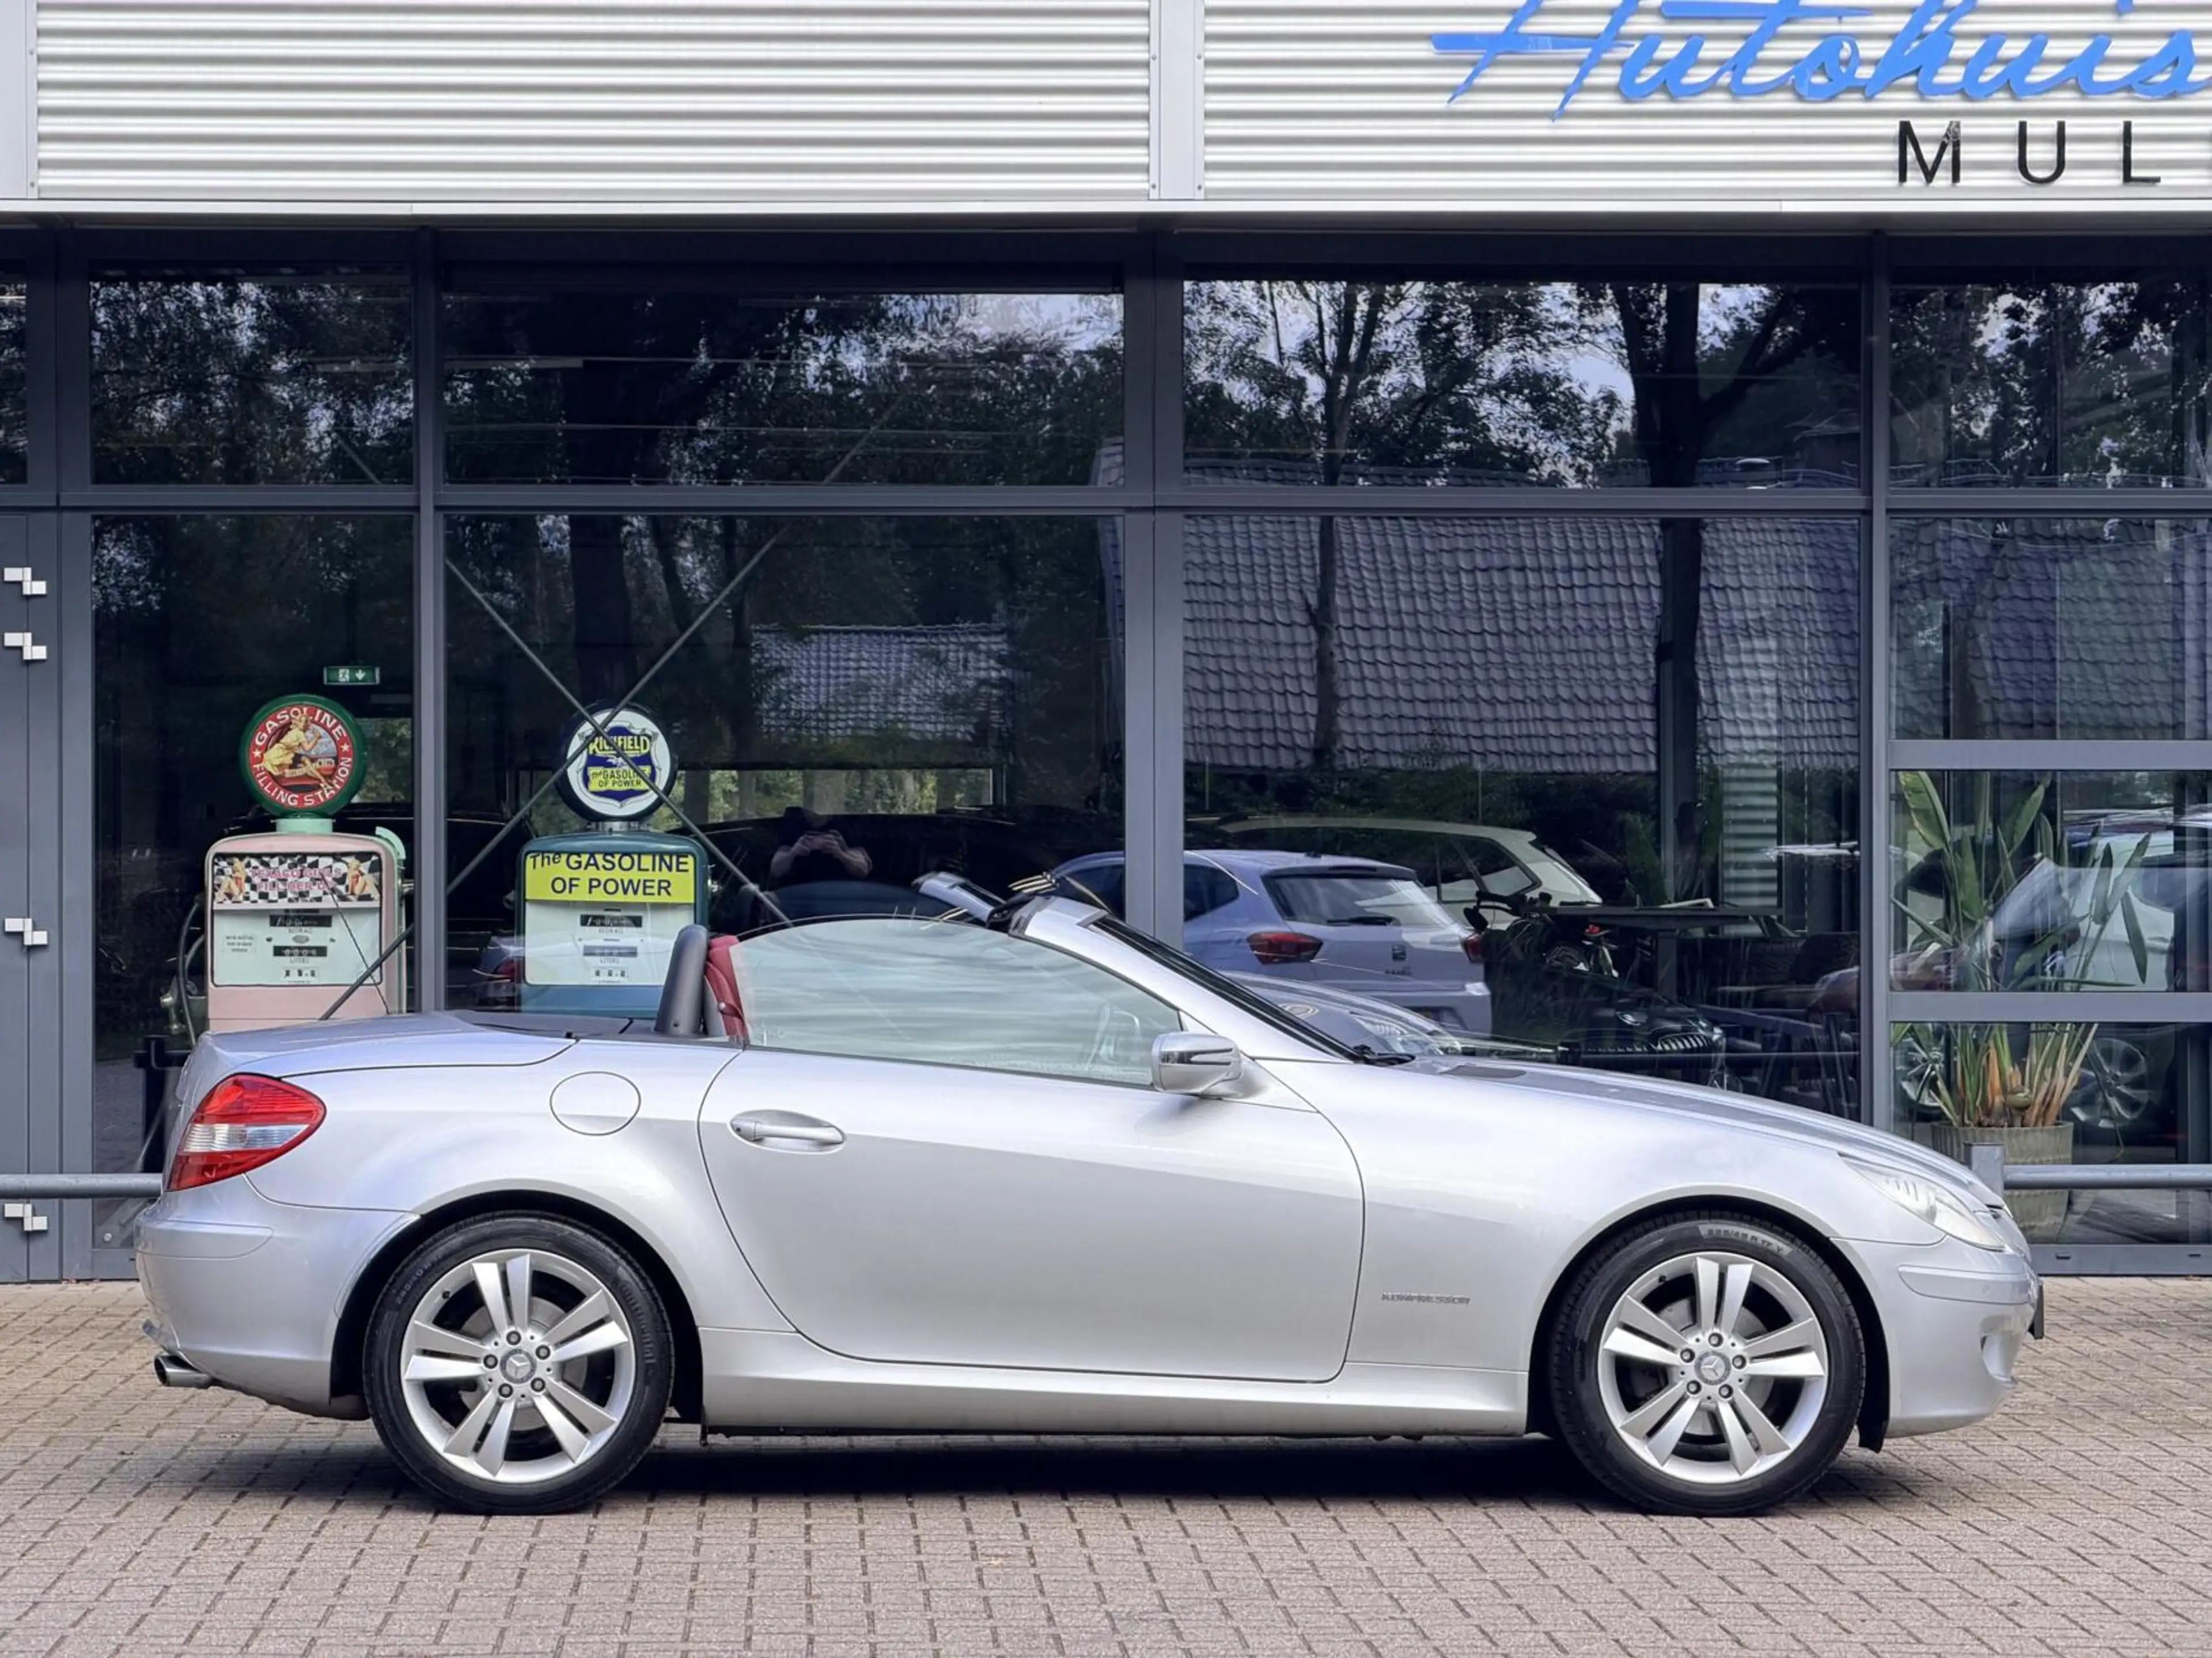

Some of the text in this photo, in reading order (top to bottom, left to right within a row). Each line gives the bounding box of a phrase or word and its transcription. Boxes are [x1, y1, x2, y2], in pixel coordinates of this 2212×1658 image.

[255, 707, 346, 746] GASOLINE
[253, 757, 352, 806] FILLING STATION
[530, 852, 690, 872] The GASOLINE
[551, 877, 672, 896] OF POWER
